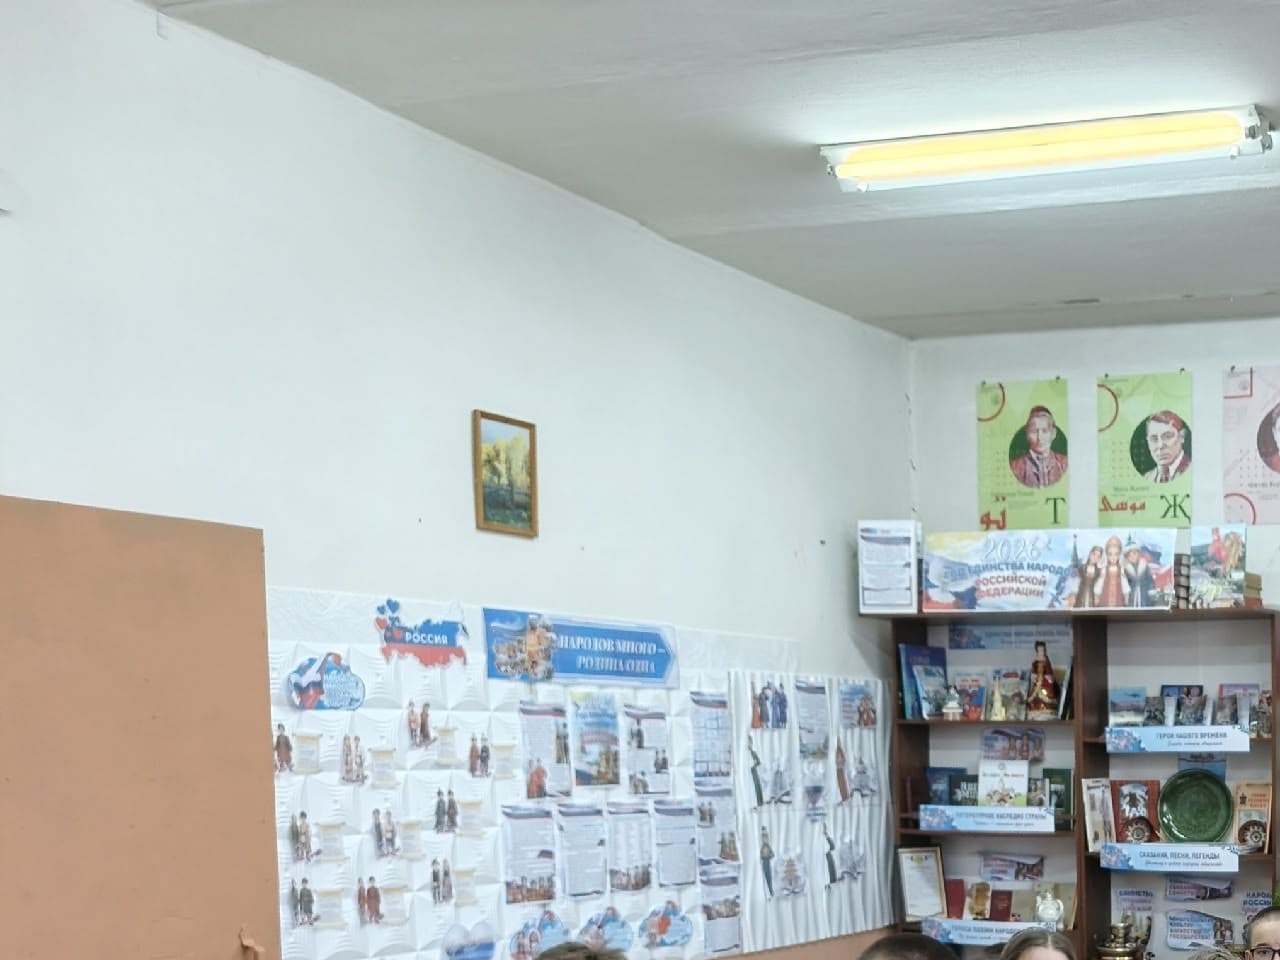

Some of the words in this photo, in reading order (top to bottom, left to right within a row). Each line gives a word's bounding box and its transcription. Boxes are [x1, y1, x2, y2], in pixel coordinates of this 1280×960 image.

[1045, 497, 1065, 524] Т
[983, 537, 1042, 562] 2026
[968, 561, 1025, 576] ЕДИНСТВА
[975, 573, 1047, 587] РОССИЙСКОЙ
[976, 587, 1045, 598] ФЕДЕРАЦИИ
[405, 632, 449, 645] РОССИЯ
[559, 635, 614, 651] НАРОДОВ
[576, 655, 624, 671] РОДИНА
